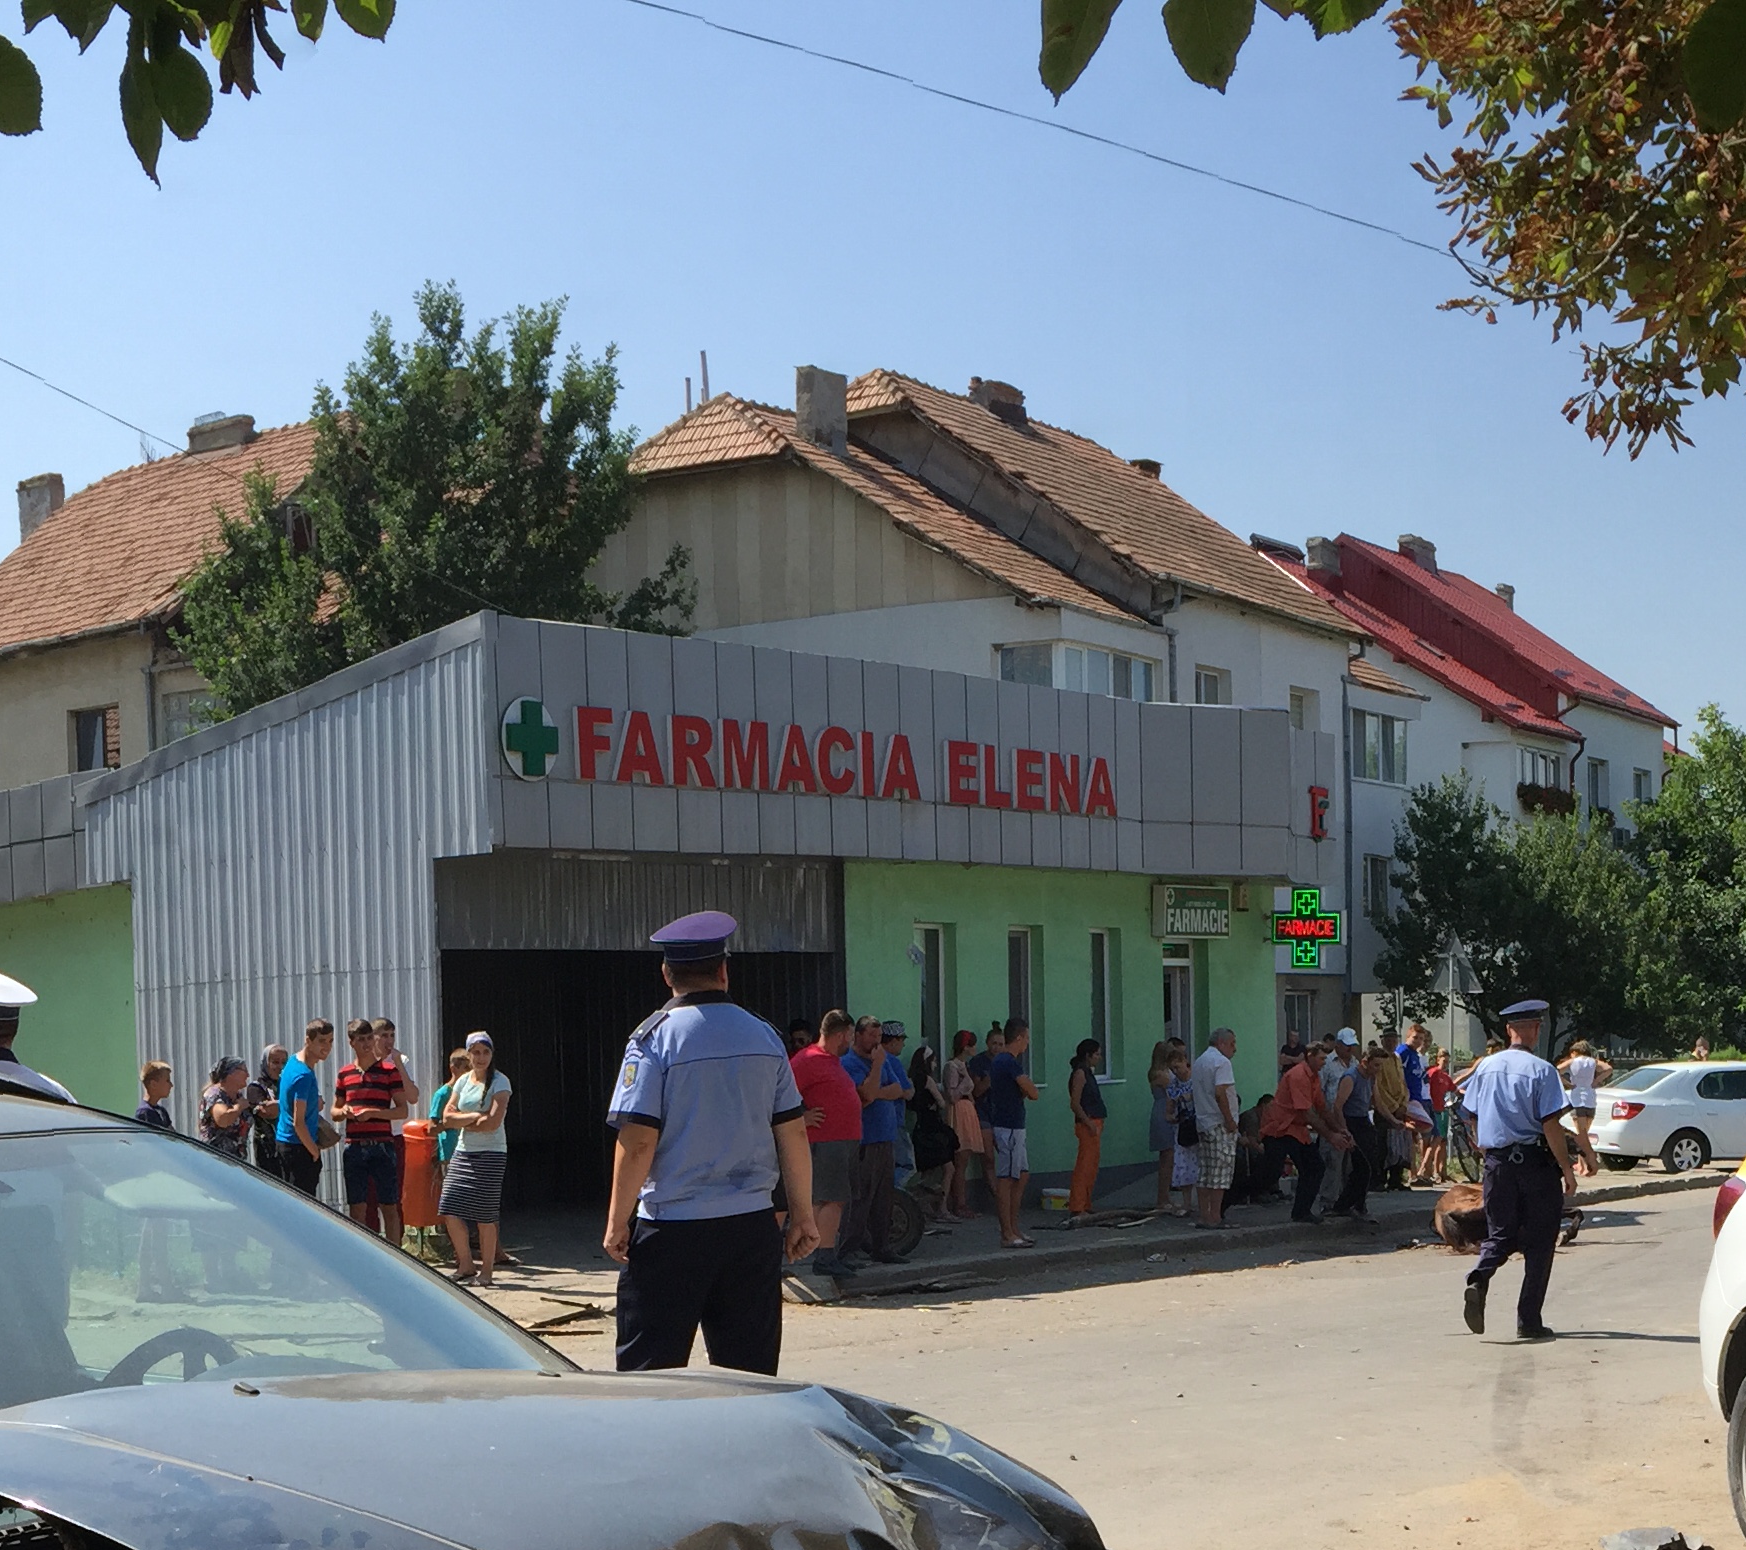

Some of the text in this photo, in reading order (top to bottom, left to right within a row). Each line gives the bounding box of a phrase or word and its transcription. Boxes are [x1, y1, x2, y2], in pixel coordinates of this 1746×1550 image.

[573, 706, 1117, 816] FARMACIA ELENA
[1167, 908, 1229, 933] FARMACIE
[1277, 919, 1335, 936] FARMACIE
